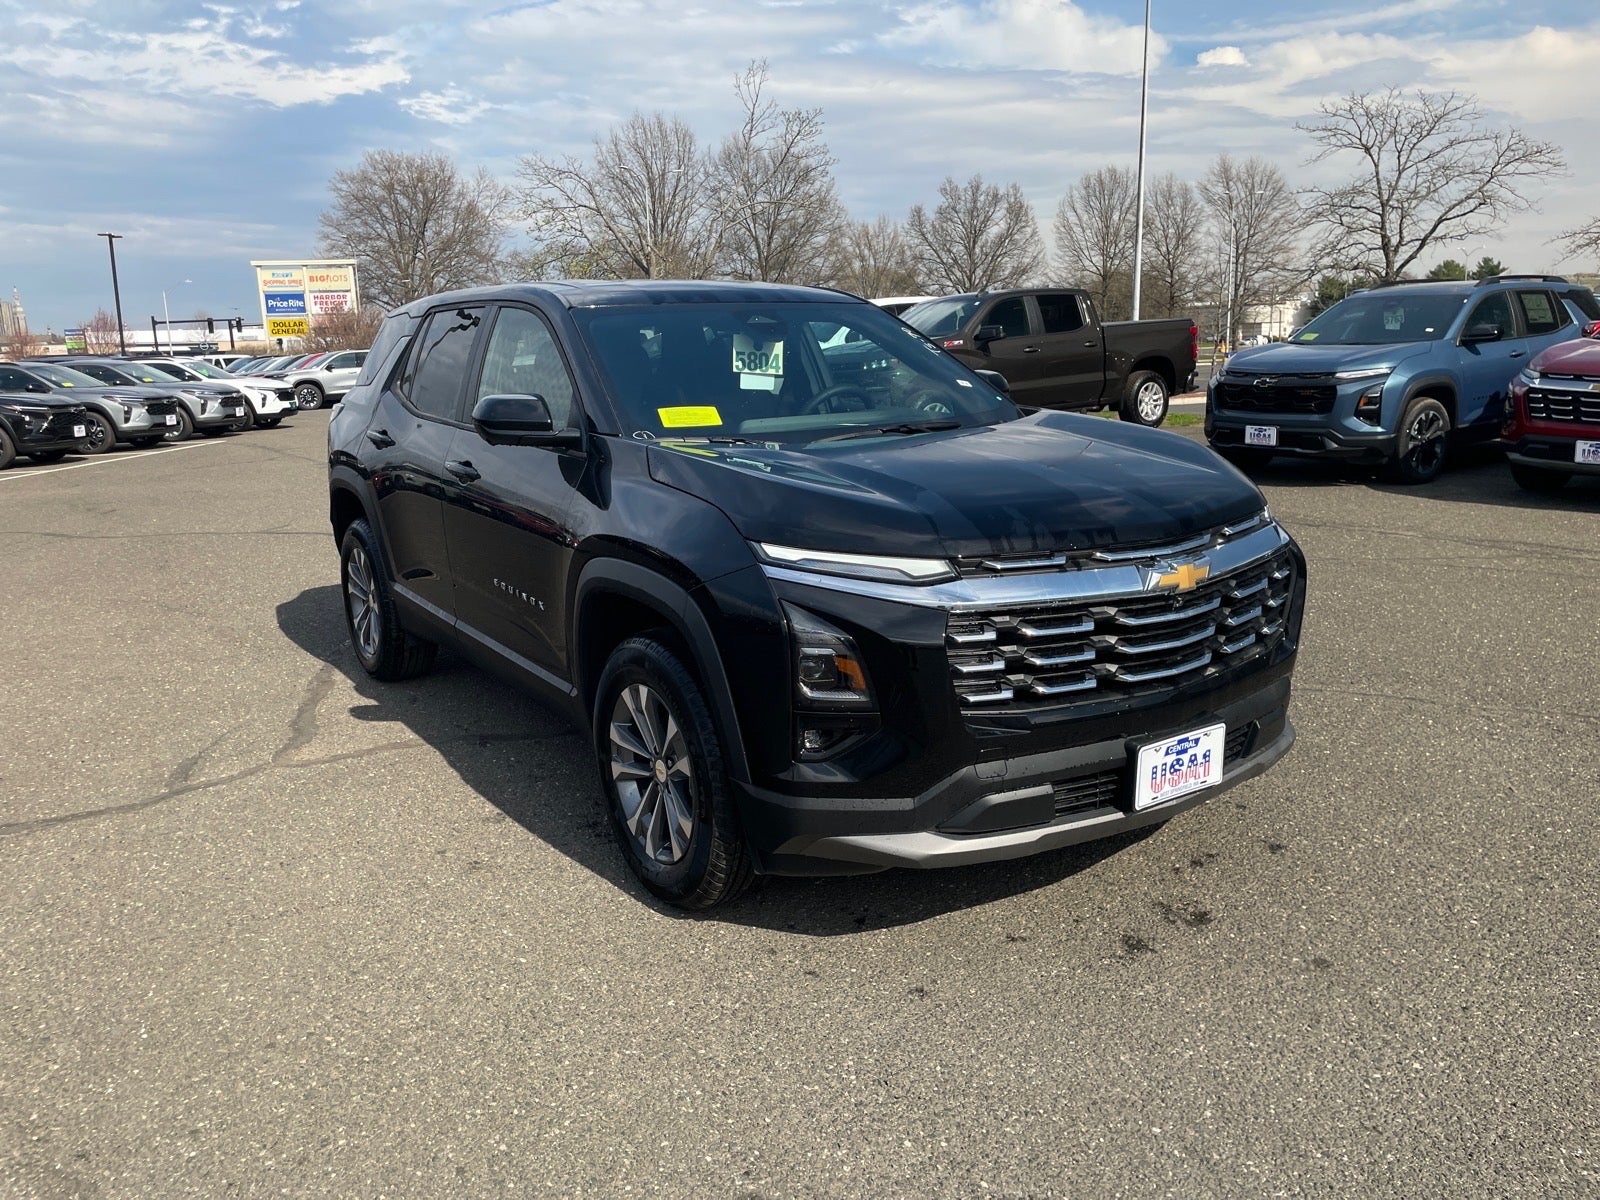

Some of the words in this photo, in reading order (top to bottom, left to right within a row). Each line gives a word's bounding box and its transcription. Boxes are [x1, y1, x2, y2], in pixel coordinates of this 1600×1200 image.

[735, 350, 781, 373] 5804
[493, 578, 545, 611] EQUINOX
[1168, 739, 1197, 754] CENTRAL
